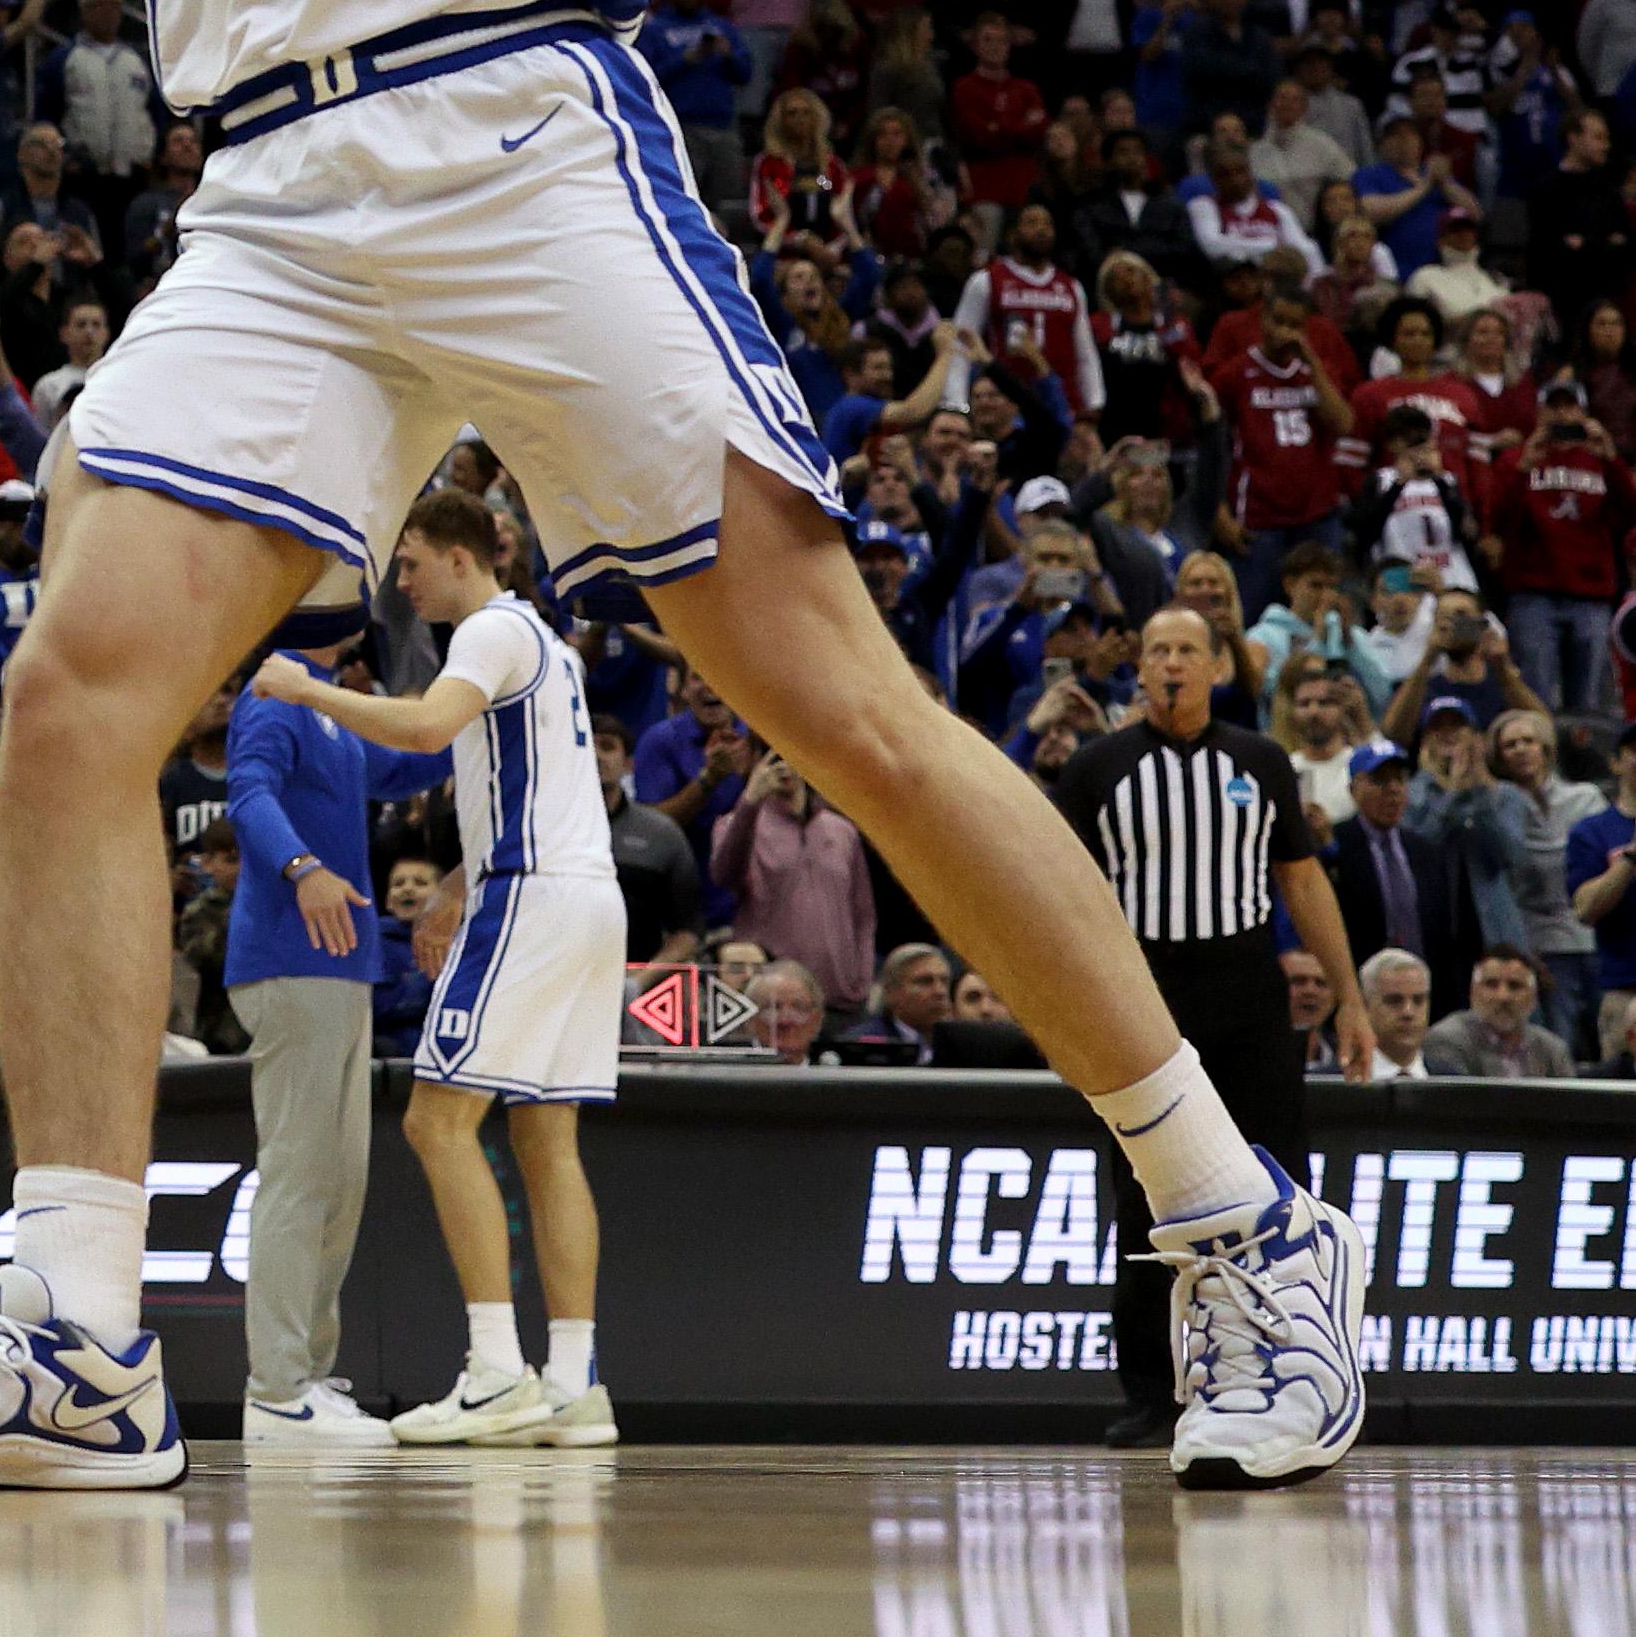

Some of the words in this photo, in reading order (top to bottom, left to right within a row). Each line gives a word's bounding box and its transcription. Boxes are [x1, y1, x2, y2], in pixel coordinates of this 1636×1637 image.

[1273, 408, 1313, 447] 15
[438, 1007, 470, 1039] D
[1401, 1314, 1518, 1373] HALL
